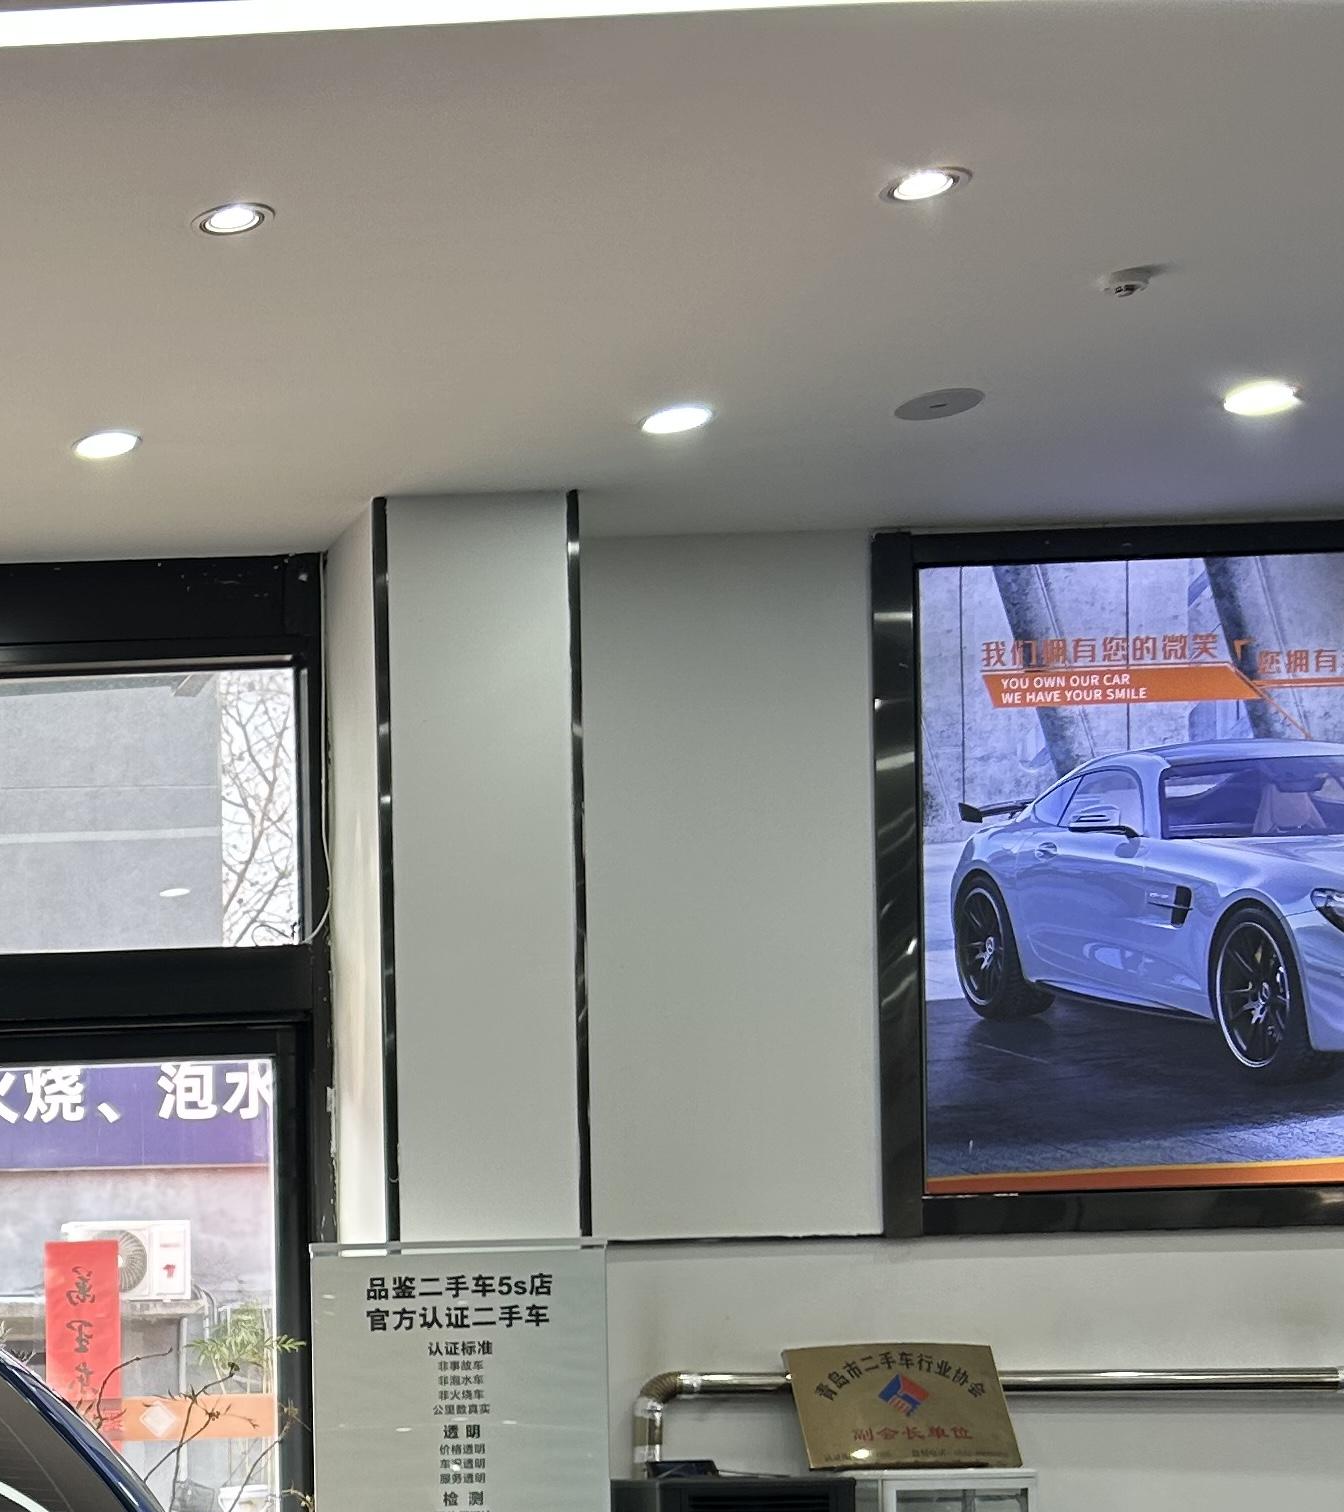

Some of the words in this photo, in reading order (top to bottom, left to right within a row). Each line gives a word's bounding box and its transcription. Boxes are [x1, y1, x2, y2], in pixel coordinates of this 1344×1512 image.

[1001, 677, 1029, 690] YOU
[1033, 676, 1066, 689] OWN
[1070, 674, 1100, 687] OUR
[1103, 673, 1131, 686] CAR
[1001, 692, 1022, 704] WE
[1026, 690, 1062, 703] HAVE
[1064, 689, 1103, 702] YOUR
[1106, 687, 1147, 700] SMILE
[366, 1273, 553, 1300] 品鉴二手车5s店
[366, 1304, 550, 1331] 官方认证二手车
[428, 1340, 493, 1356] 认证标准
[438, 1360, 484, 1371] 非事故车
[815, 1351, 987, 1401] 青岛市二手车行业协会
[438, 1389, 484, 1401] 非火烧车
[433, 1403, 490, 1415] 公里数真实
[439, 1443, 486, 1455] 价格透明
[440, 1472, 486, 1484] 服务透明
